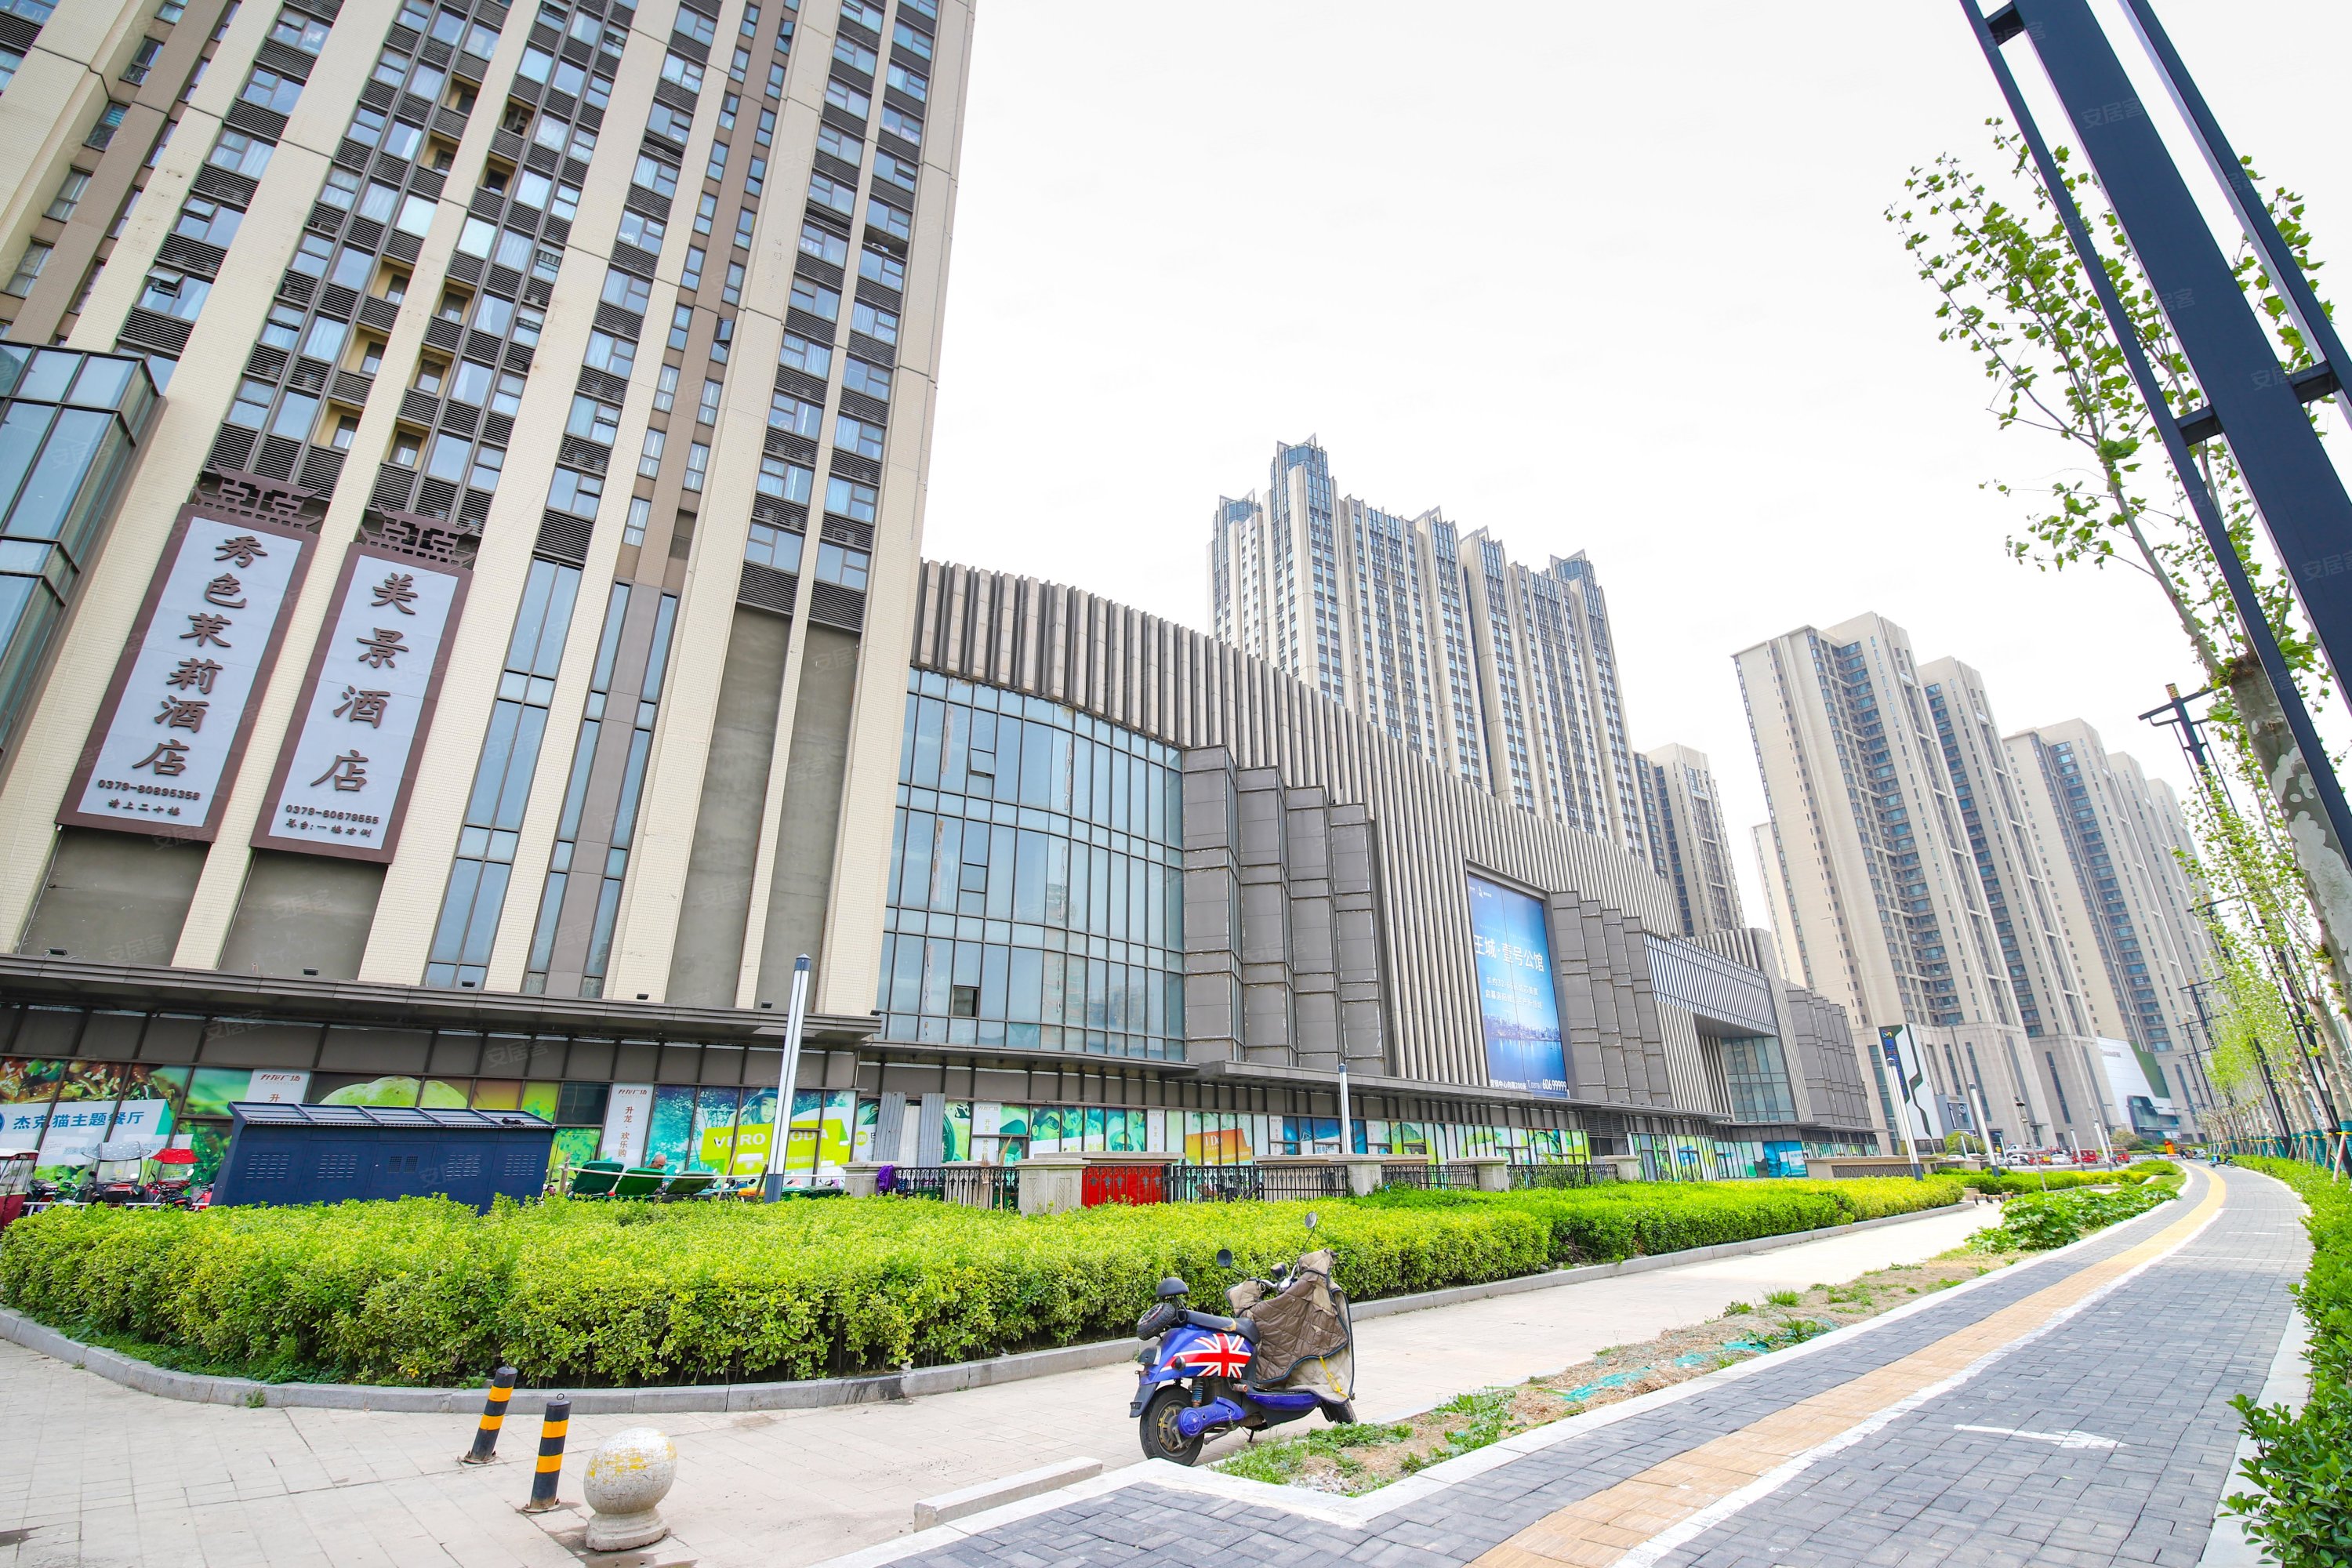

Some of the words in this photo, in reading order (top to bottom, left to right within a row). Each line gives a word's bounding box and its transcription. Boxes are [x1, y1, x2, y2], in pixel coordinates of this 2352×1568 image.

[132, 535, 268, 776] 秀色茉莉酒店
[310, 572, 419, 793] 美景酒店
[13, 1111, 145, 1130] 杰克猫主题餐厅
[789, 1129, 829, 1142] ODA
